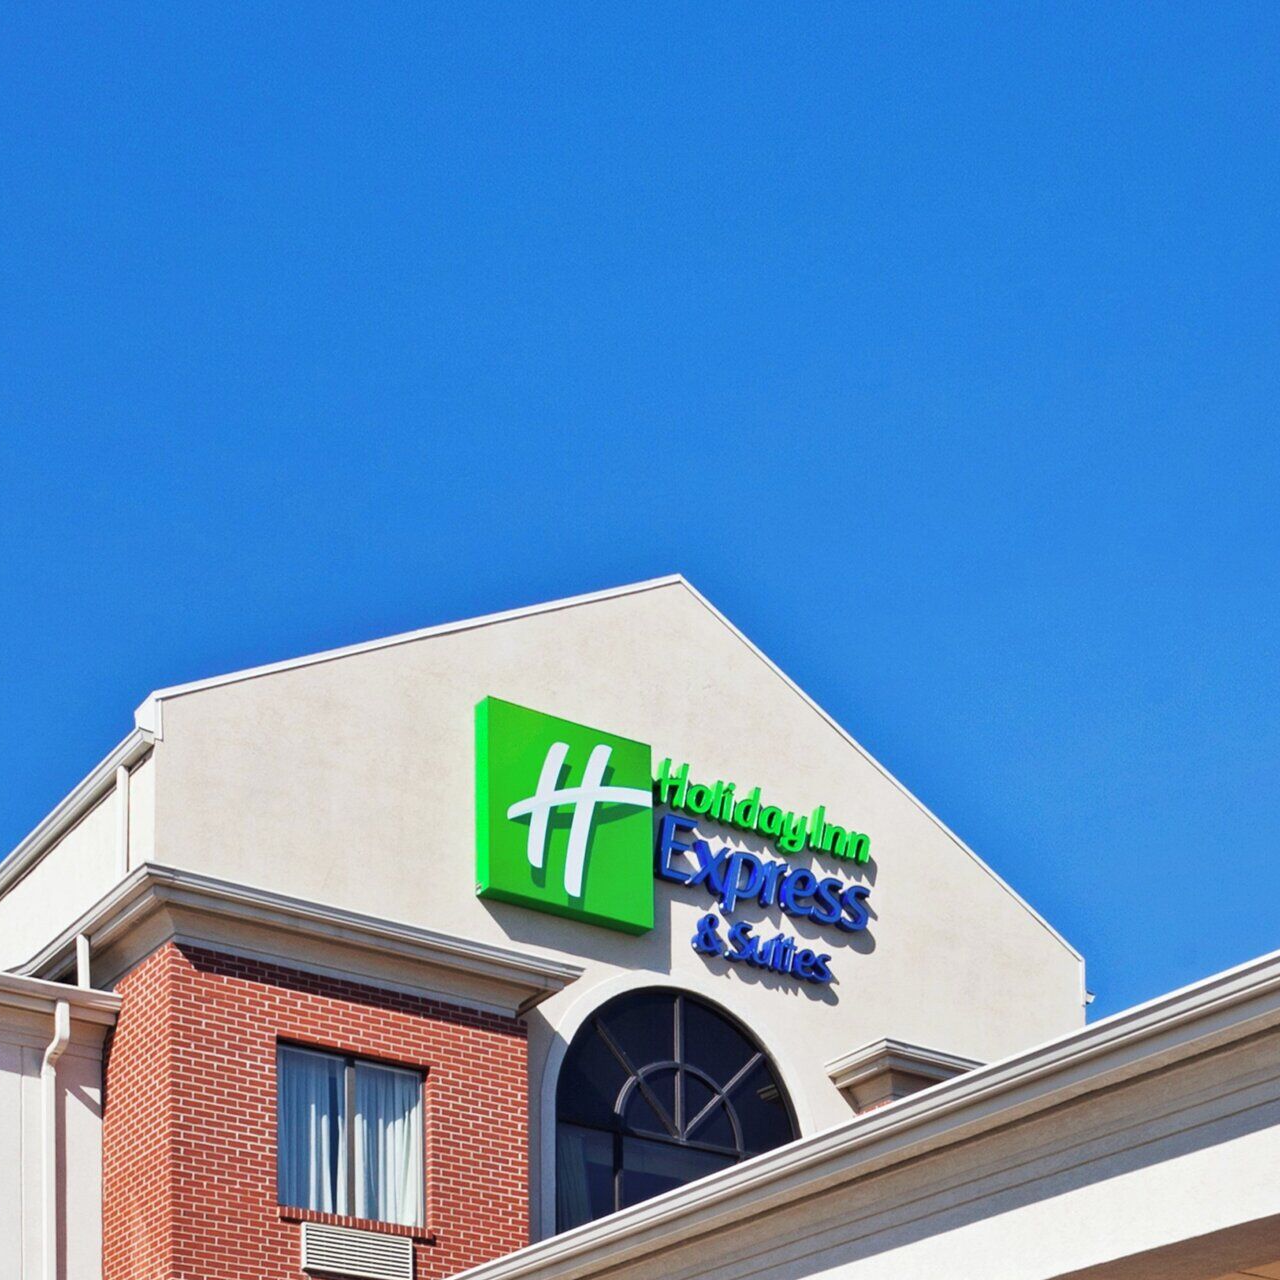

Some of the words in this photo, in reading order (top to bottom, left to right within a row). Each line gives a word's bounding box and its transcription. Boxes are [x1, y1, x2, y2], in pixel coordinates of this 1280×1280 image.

[657, 758, 807, 854] Holiday
[810, 805, 871, 864] Inn
[655, 814, 871, 932] Express
[691, 913, 724, 956] &
[723, 921, 832, 983] Suites
